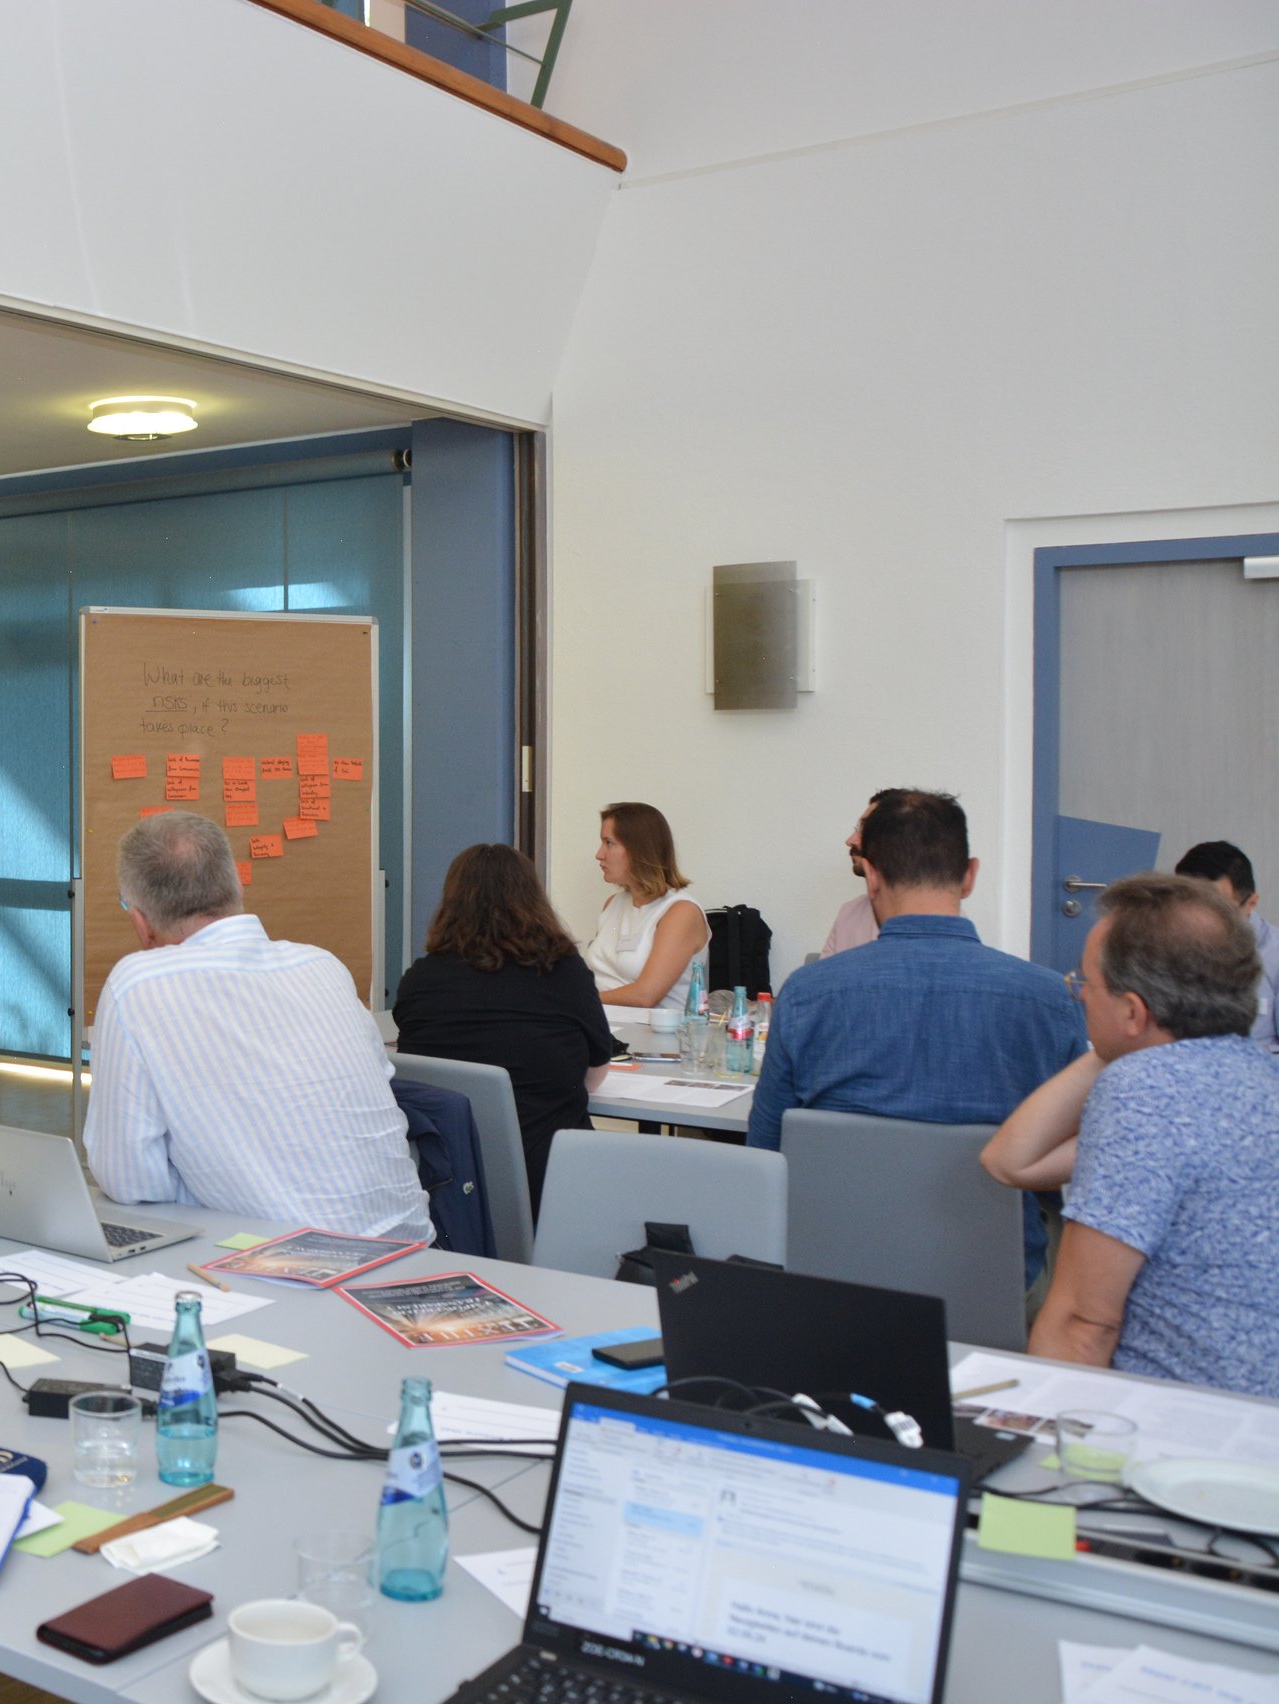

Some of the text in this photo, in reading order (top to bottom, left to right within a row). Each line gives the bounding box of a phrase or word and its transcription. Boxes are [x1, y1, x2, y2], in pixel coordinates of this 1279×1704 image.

[143, 662, 291, 690] What are the biggest
[217, 700, 238, 713] this
[244, 702, 289, 714] scenario
[140, 718, 174, 733] takes
